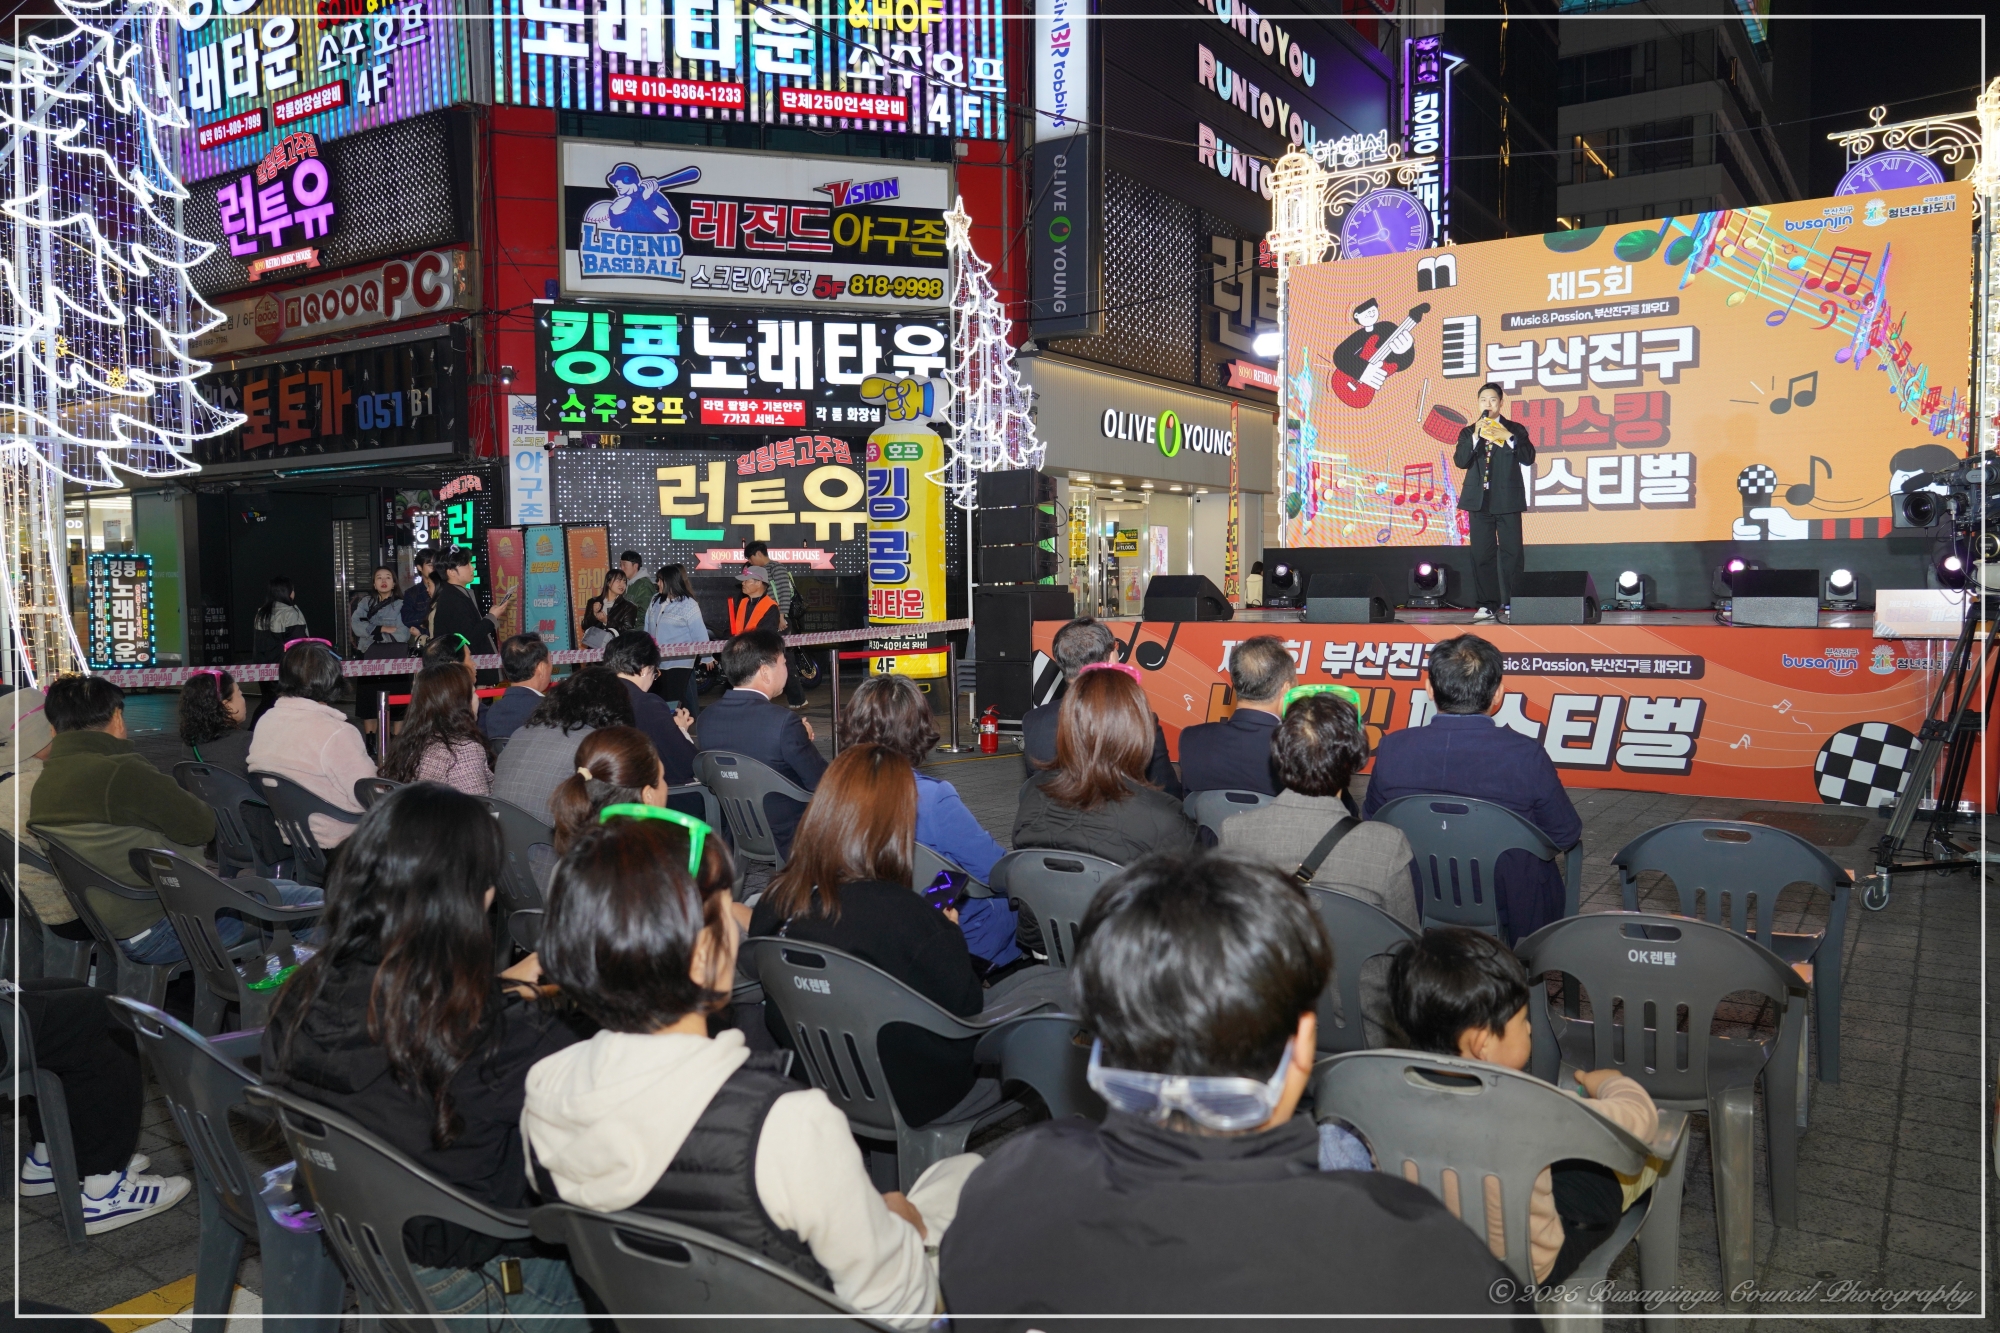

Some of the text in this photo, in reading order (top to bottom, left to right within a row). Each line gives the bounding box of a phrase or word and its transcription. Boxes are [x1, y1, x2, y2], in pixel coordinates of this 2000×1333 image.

[356, 63, 392, 107] 4F
[612, 79, 743, 104] 예약 010-9364-1233
[1052, 60, 1068, 130] robbins
[1198, 42, 1316, 155] RUNTOYOU
[782, 90, 905, 119] 단체250인석완비
[928, 92, 982, 130] 4F
[214, 112, 261, 141] 051-809-7999
[823, 177, 900, 207] VISION
[1053, 154, 1067, 212] OLIVE
[217, 156, 336, 257] 런투유
[1822, 205, 1854, 217] 부산진구
[689, 200, 946, 258] 레전드 야구존
[1785, 215, 1853, 231] busanjin
[582, 223, 682, 257] LEGEND
[583, 255, 683, 278] BASEBALL
[1053, 244, 1067, 313] YOUNG
[303, 251, 446, 325] QOOQ PC
[690, 265, 944, 299] 스크린야구장 5F 818-9998
[1547, 264, 1633, 302] 제5회
[1510, 301, 1670, 328] Music & Passion, 부산진구를 채우다
[551, 310, 682, 389] 킹콩
[1486, 325, 1697, 391] 부산진구
[1238, 364, 1253, 380] 8090
[1253, 369, 1272, 386] RETRO
[243, 369, 353, 451] 토토가
[358, 391, 404, 431] 051
[560, 391, 618, 424] 소주
[630, 394, 687, 425] 호프
[703, 400, 804, 414] 라면 팔빙수 기본안주
[722, 413, 786, 426] 7가지 서비스
[815, 407, 881, 423] 각 룸 화장실
[1511, 390, 1666, 448] 버스킹
[1102, 408, 1233, 457] OLIVE YOUNG
[736, 435, 854, 476] 힐링복고주점
[866, 445, 878, 460] 주
[888, 443, 919, 459] 호프
[1520, 452, 1693, 508] 스티벌
[656, 461, 868, 542] 런투유
[867, 466, 910, 585] 킹콩
[110, 560, 137, 578] 킹콩
[711, 550, 731, 561] 8090
[791, 550, 821, 562] HOUSE
[111, 577, 137, 663] 노래타운
[1930, 608, 1963, 622] 페스
[876, 657, 896, 673] 4F
[1503, 657, 1692, 675] sic & Passion, 부산진구를 채우다
[1782, 653, 1859, 670] busanjin
[1824, 647, 1860, 657] 부산진구
[1627, 947, 1677, 968] OK렌탈
[793, 975, 832, 996] OK렌탈
